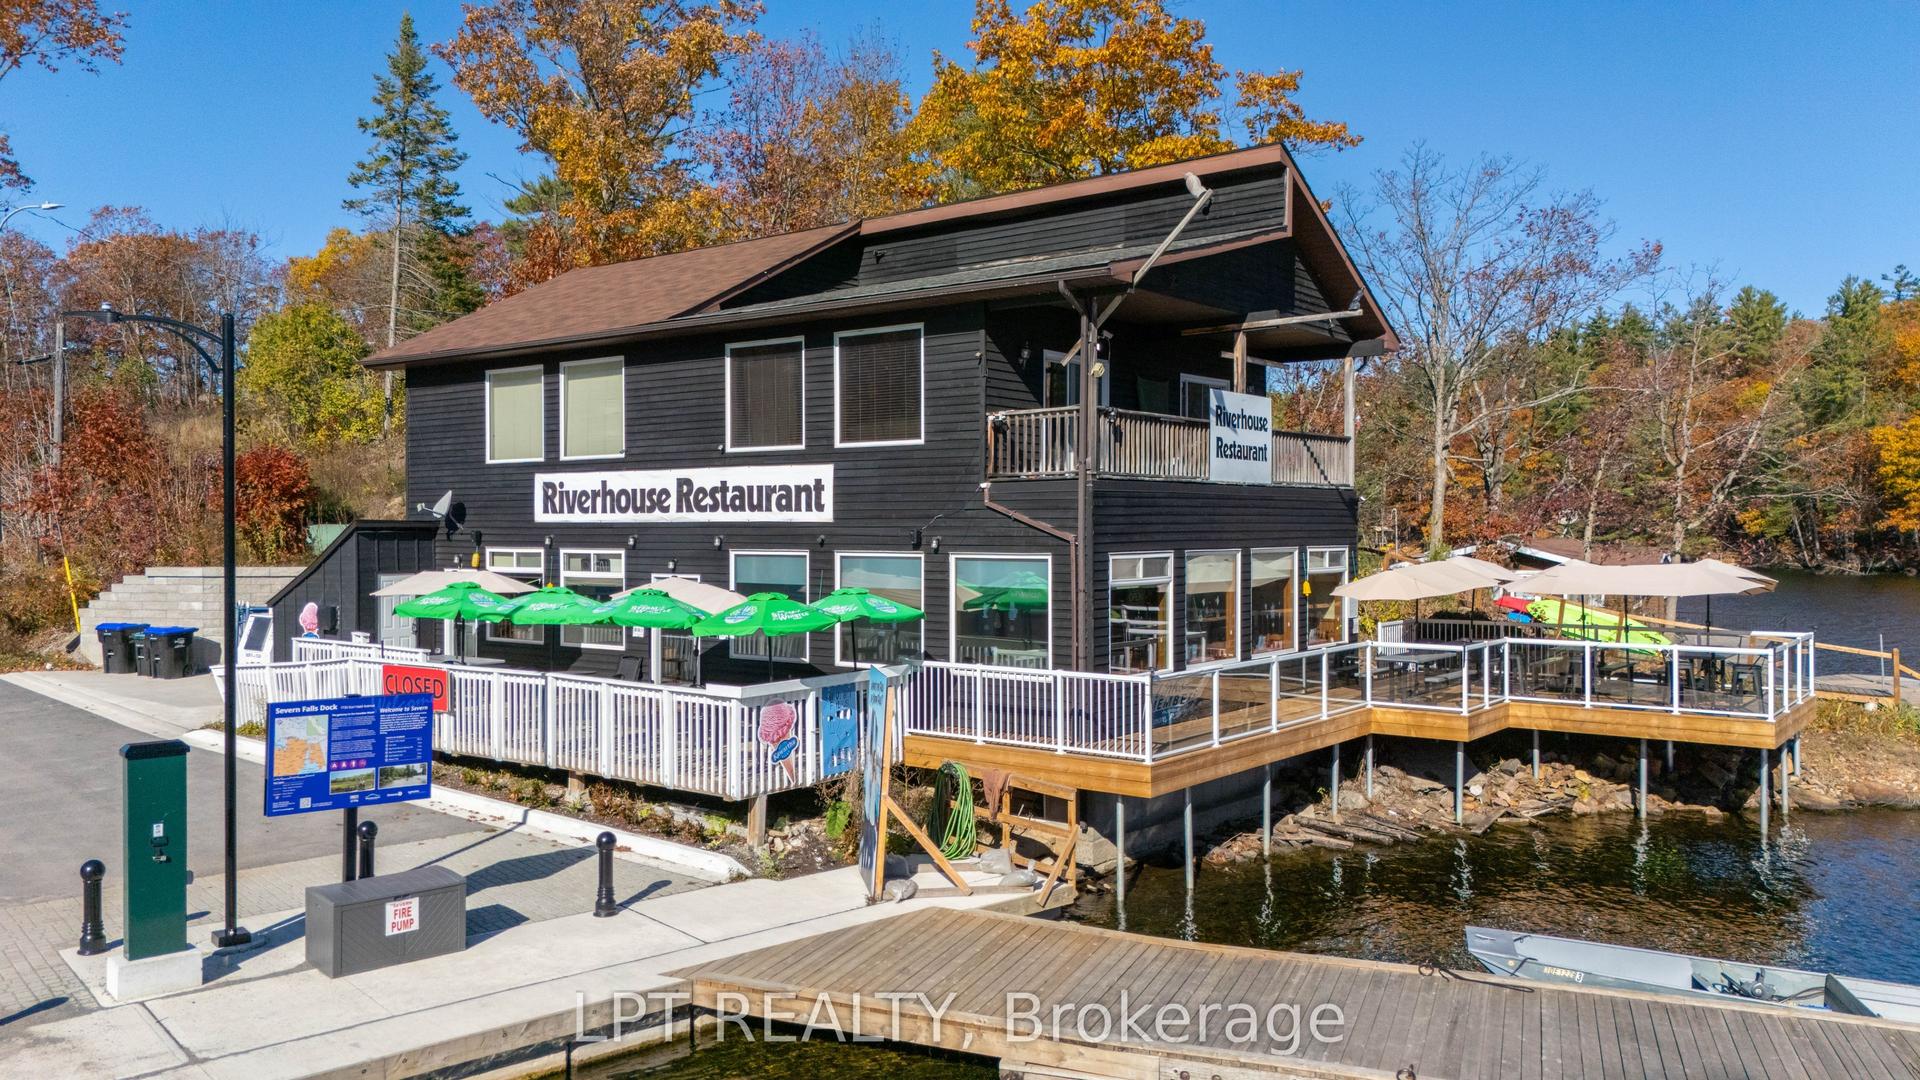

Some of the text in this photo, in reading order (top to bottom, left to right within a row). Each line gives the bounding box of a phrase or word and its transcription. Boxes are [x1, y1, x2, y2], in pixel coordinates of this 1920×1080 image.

[1215, 404, 1269, 433] Riverhouse
[1215, 436, 1268, 462] Restaurant
[542, 477, 826, 515] Riverhouse Restaurant
[385, 674, 444, 699] CLOSED
[275, 707, 301, 715] Severn
[391, 918, 414, 932] PUMP
[394, 907, 412, 920] FIRE
